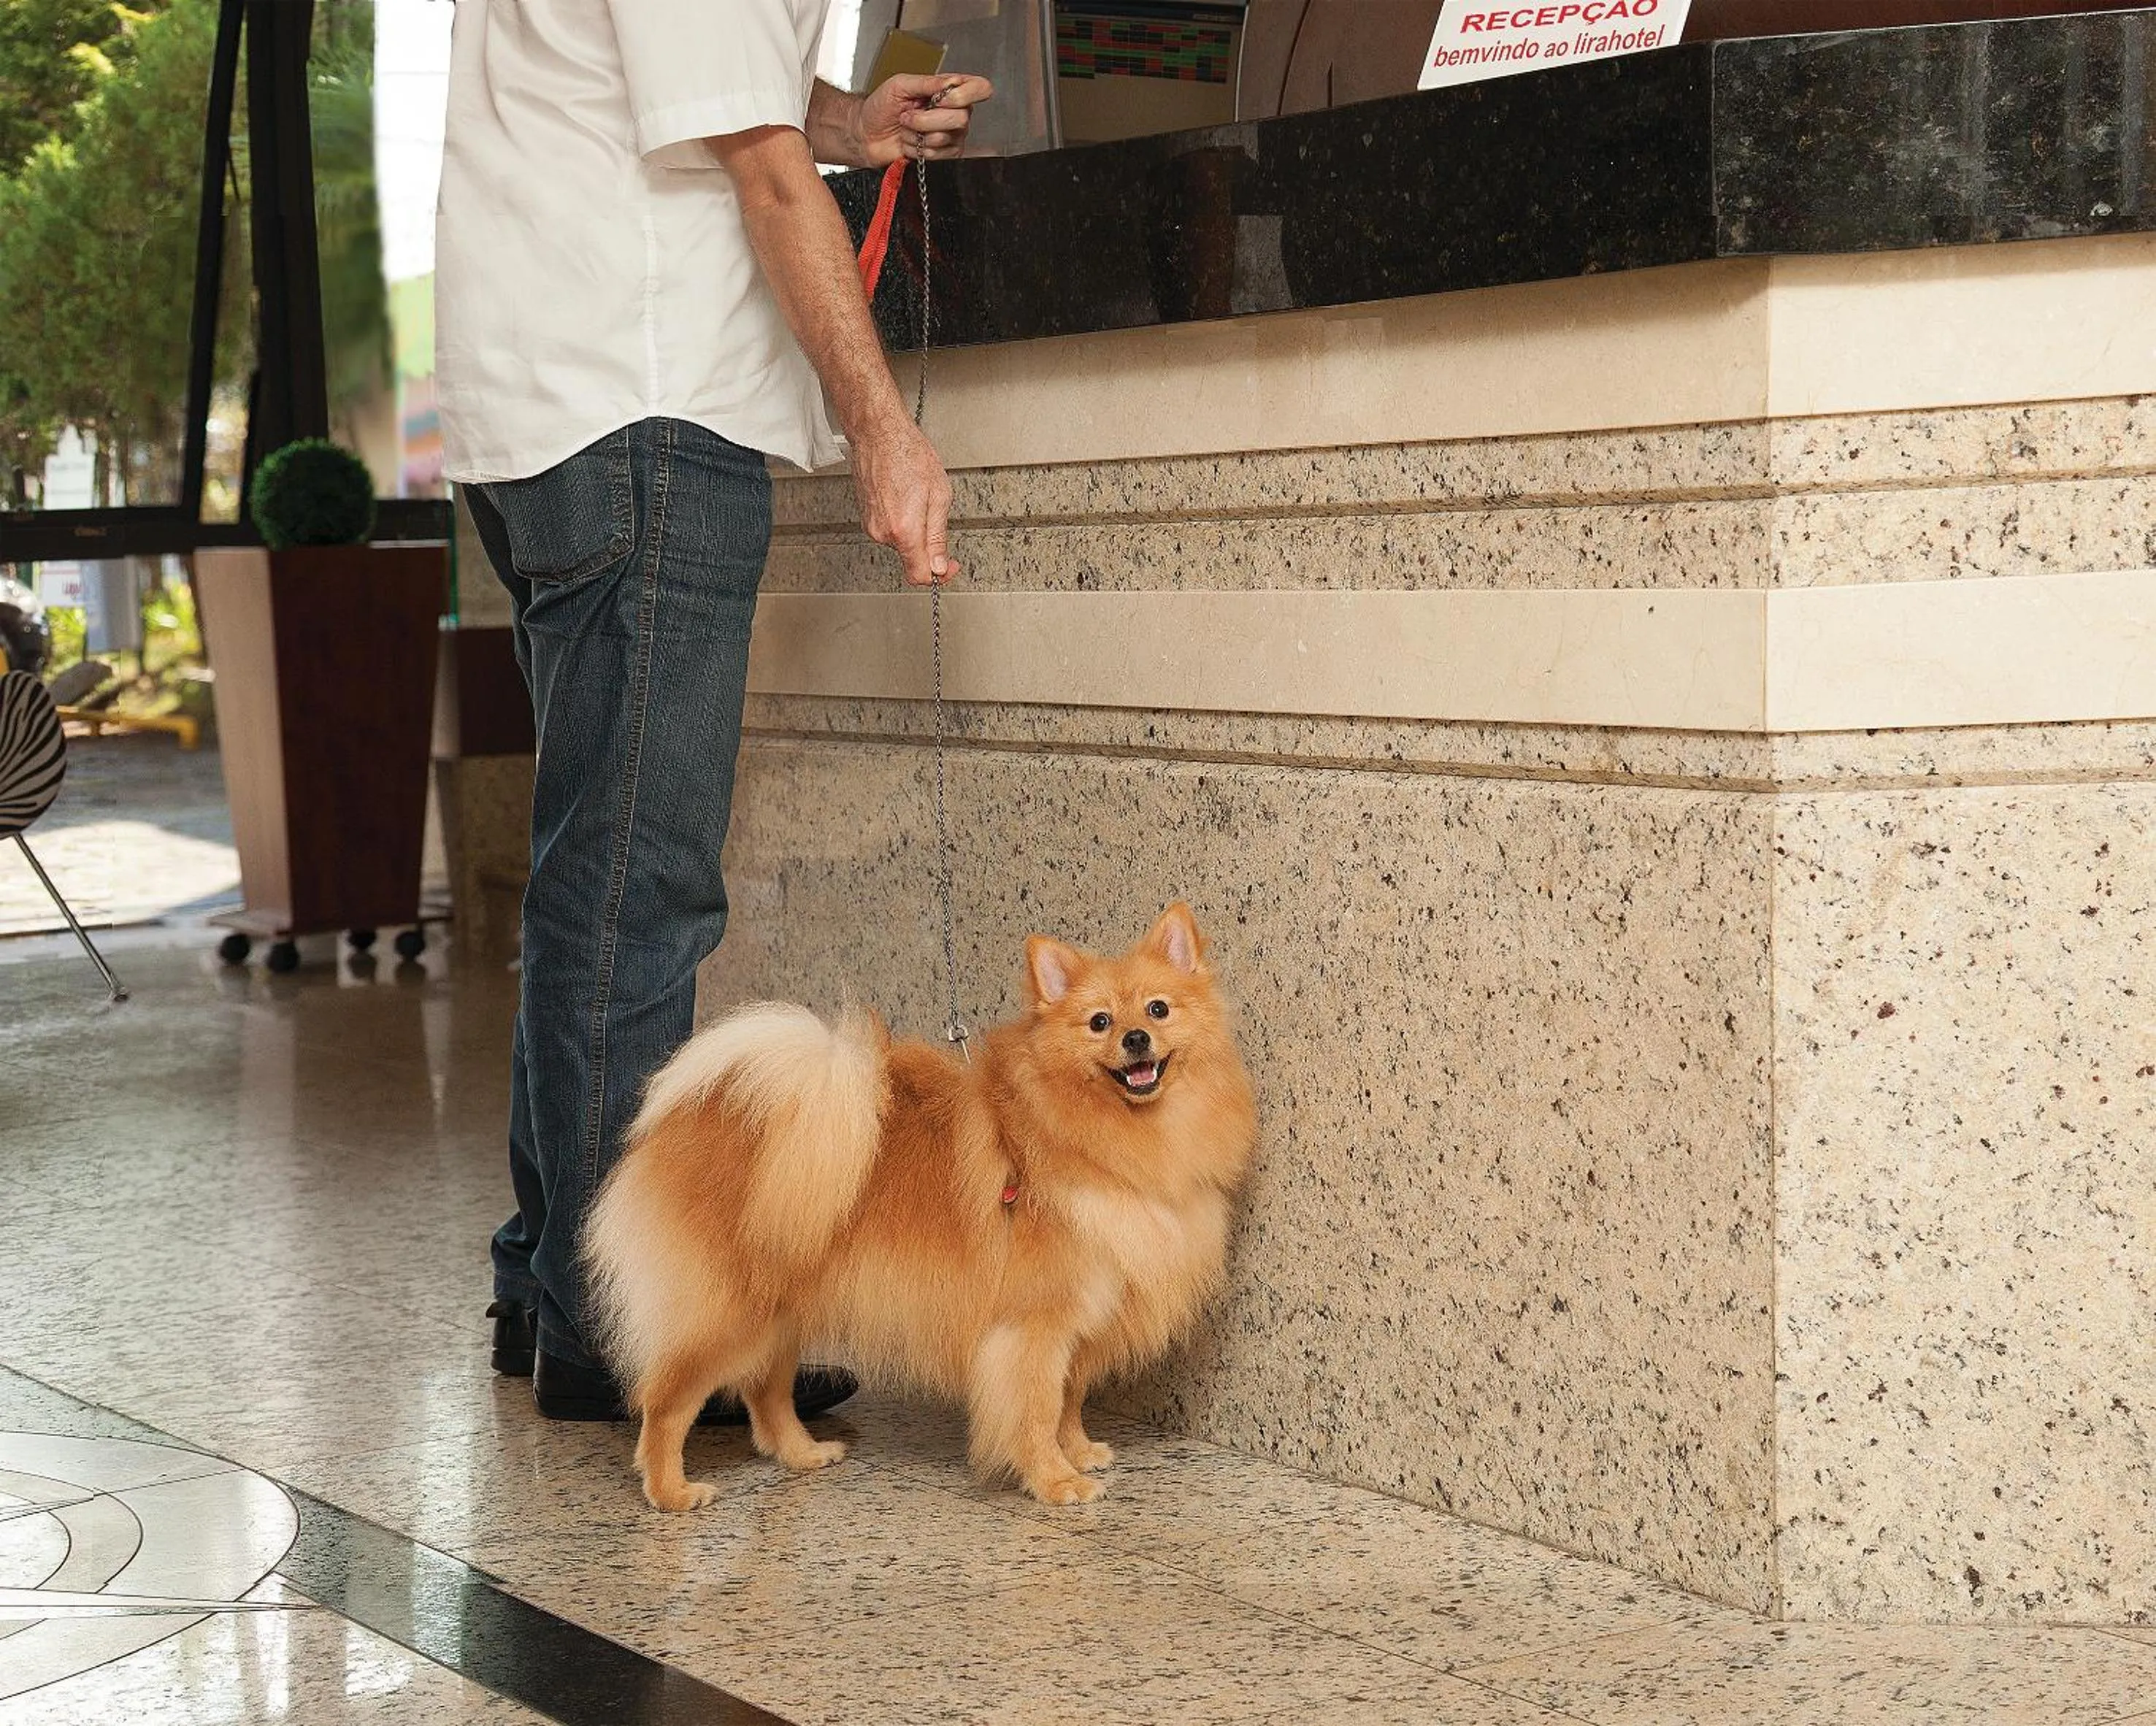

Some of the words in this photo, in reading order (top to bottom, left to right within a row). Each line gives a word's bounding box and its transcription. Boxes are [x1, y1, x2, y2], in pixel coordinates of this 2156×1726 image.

[1434, 38, 1539, 67] bemvindo
[1543, 39, 1568, 58] ao
[1573, 24, 1665, 55] lirahotel
